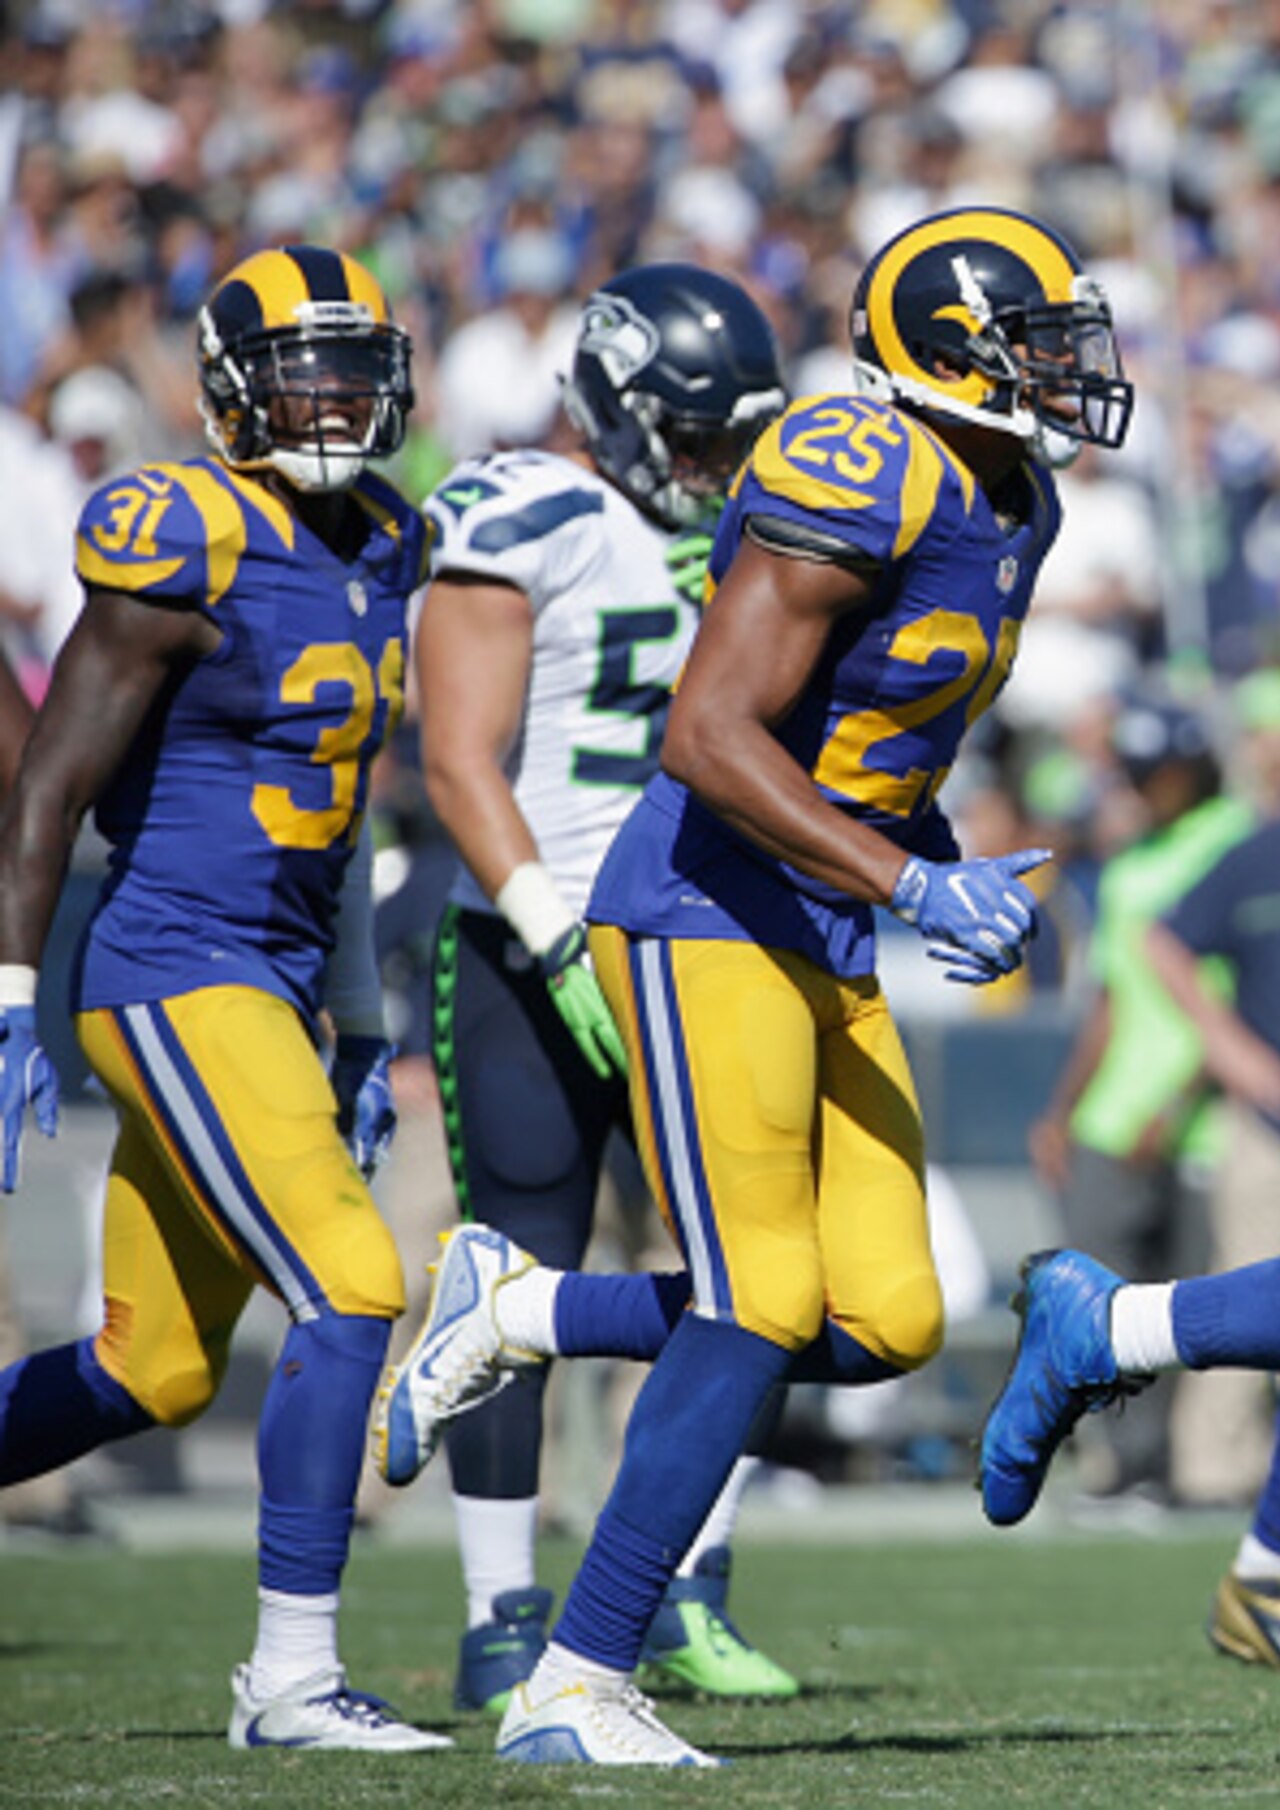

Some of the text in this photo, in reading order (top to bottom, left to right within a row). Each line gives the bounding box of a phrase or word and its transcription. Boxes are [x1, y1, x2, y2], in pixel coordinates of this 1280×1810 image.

[785, 407, 902, 483] 25
[91, 486, 173, 557] 31
[568, 603, 681, 791] 5
